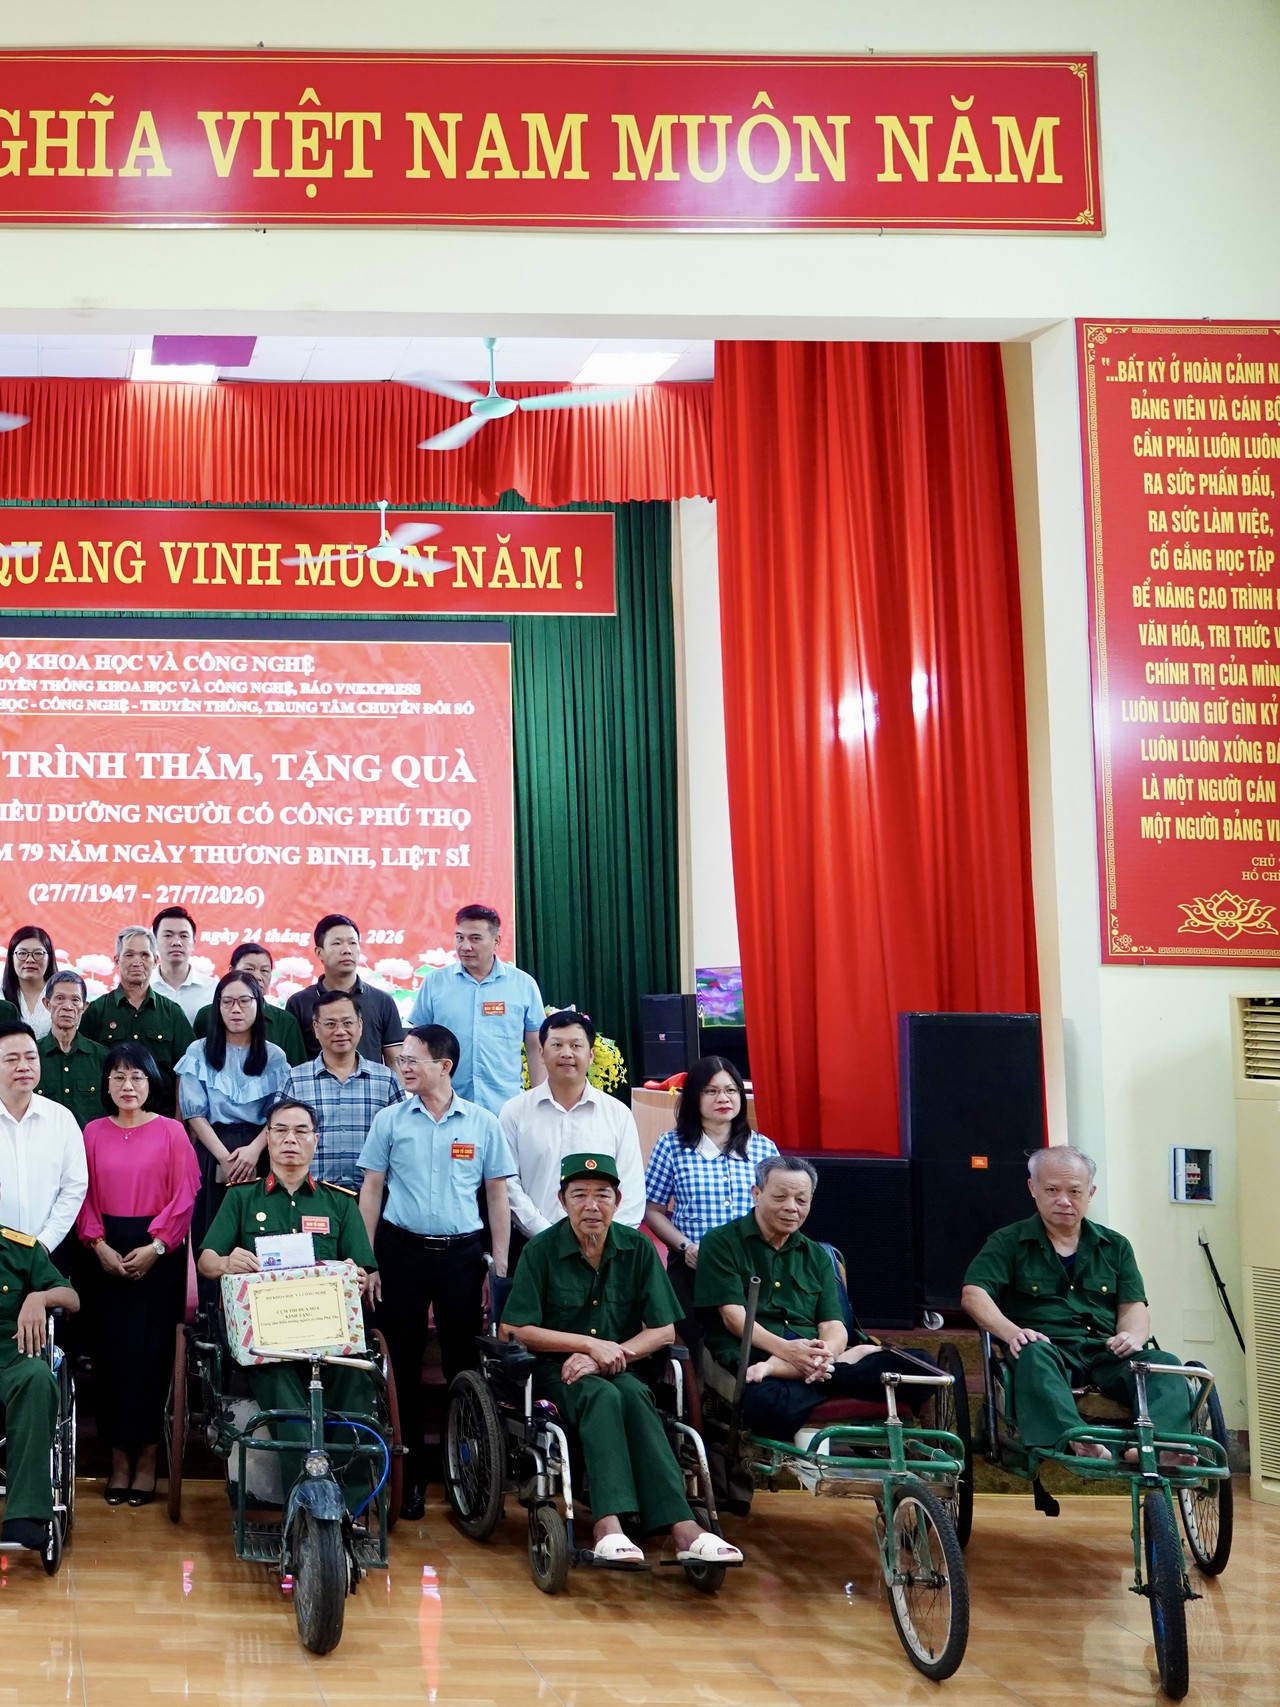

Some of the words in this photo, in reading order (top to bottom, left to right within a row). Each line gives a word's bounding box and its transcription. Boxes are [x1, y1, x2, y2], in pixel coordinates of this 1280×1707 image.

[198, 88, 381, 197] VIỆT
[406, 113, 589, 179] NAM
[612, 92, 850, 183] MUÔN
[875, 95, 1062, 183] NĂM
[1148, 357, 1165, 382] KỲ
[1170, 353, 1180, 383] Ở
[1183, 356, 1222, 383] HOÀN
[1226, 354, 1264, 383] CẢNH
[1131, 389, 1170, 420] ĐẢNG
[1173, 395, 1205, 420] VIÊN
[1209, 395, 1228, 420] VÀ
[1232, 395, 1261, 421] CÁN
[1134, 428, 1162, 457] CẦN
[1167, 427, 1199, 457] PHẢI
[1204, 432, 1240, 458] LUÔN
[1144, 473, 1163, 494] RA
[1167, 467, 1195, 495] SỨC
[1199, 466, 1238, 495] PHẤN
[1242, 467, 1274, 498] ĐẤU,
[1149, 511, 1168, 532] RA
[1172, 505, 1199, 533] SỨC
[1204, 507, 1234, 533] LÀM
[1238, 508, 1273, 538] VIỆC,
[160, 542, 281, 585] VINH
[295, 530, 439, 588] MUÔN
[452, 534, 562, 588] NĂM
[575, 547, 582, 589] !
[1150, 541, 1169, 570] CỐ
[1173, 542, 1212, 570] GẮNG
[1216, 550, 1244, 576] HỌC
[1248, 546, 1274, 576] TẬP
[1133, 577, 1151, 607] ĐỂ
[1155, 582, 1194, 608] NÂNG
[1199, 587, 1226, 609] CAO
[1231, 583, 1272, 609] TRÌNH
[1139, 620, 1167, 646] VĂN
[1172, 620, 1204, 649] HÓA,
[1208, 625, 1230, 647] TRI
[1234, 620, 1270, 648] THỨC
[25, 654, 91, 670] KHOA
[94, 655, 143, 674] HỌC
[147, 651, 179, 671] VÀ
[183, 651, 248, 672] CÔNG
[1146, 658, 1189, 684] CHÍNH
[1193, 663, 1215, 690] TRỊ
[1219, 655, 1248, 686] CỦA
[40, 677, 94, 691] THÔNG
[96, 681, 142, 692] KHOA
[143, 681, 177, 695] HỌC
[179, 679, 202, 692] VÀ
[204, 679, 248, 693] CÔNG
[300, 680, 332, 694] BÁO
[334, 683, 421, 695] VNEXPRESS
[39, 696, 84, 710] CÔNG
[204, 698, 263, 714] THÔNG,
[265, 701, 318, 713] TRUNG
[320, 699, 355, 713] TÂM
[1120, 696, 1158, 724] LUÔN
[1163, 697, 1199, 723] LUÔN
[1204, 697, 1229, 724] GIỮ
[1232, 698, 1256, 724] GÌN
[1261, 694, 1278, 725] KỶ
[1141, 735, 1177, 761] LUÔN
[1182, 736, 1219, 762] LUÔN
[1223, 735, 1262, 763] XỨNG
[2, 744, 126, 778] TRÌNH
[136, 746, 263, 786] THĂM,
[272, 750, 382, 788] TẶNG
[392, 748, 477, 788] QUÀ
[1142, 773, 1159, 799] LÀ
[1164, 774, 1194, 805] MỘT
[1198, 774, 1242, 801] NGƯỜI
[1246, 776, 1276, 802] CÁN
[47, 800, 141, 823] DƯỠNG
[146, 801, 232, 824] NGƯỜI
[237, 802, 274, 824] CÓ
[280, 802, 354, 825] CÔNG
[359, 803, 411, 826] PHÚ
[416, 808, 471, 831] THỌ
[1141, 812, 1171, 844] MỘT
[1176, 812, 1219, 840] NGƯỜI
[1223, 809, 1262, 841] ĐẢNG
[18, 844, 43, 861] 79
[48, 839, 108, 862] NĂM
[113, 840, 186, 863] NGÀY
[190, 843, 301, 864] THƯƠNG
[309, 847, 376, 869] BINH,
[381, 845, 440, 870] LIỆT
[446, 844, 470, 866] SĨ
[1252, 854, 1275, 866] CHỦ
[29, 884, 137, 905] (27/7/1947
[156, 885, 265, 908] 27/7/2026)
[241, 928, 262, 942] 24
[366, 930, 404, 944] 2026
